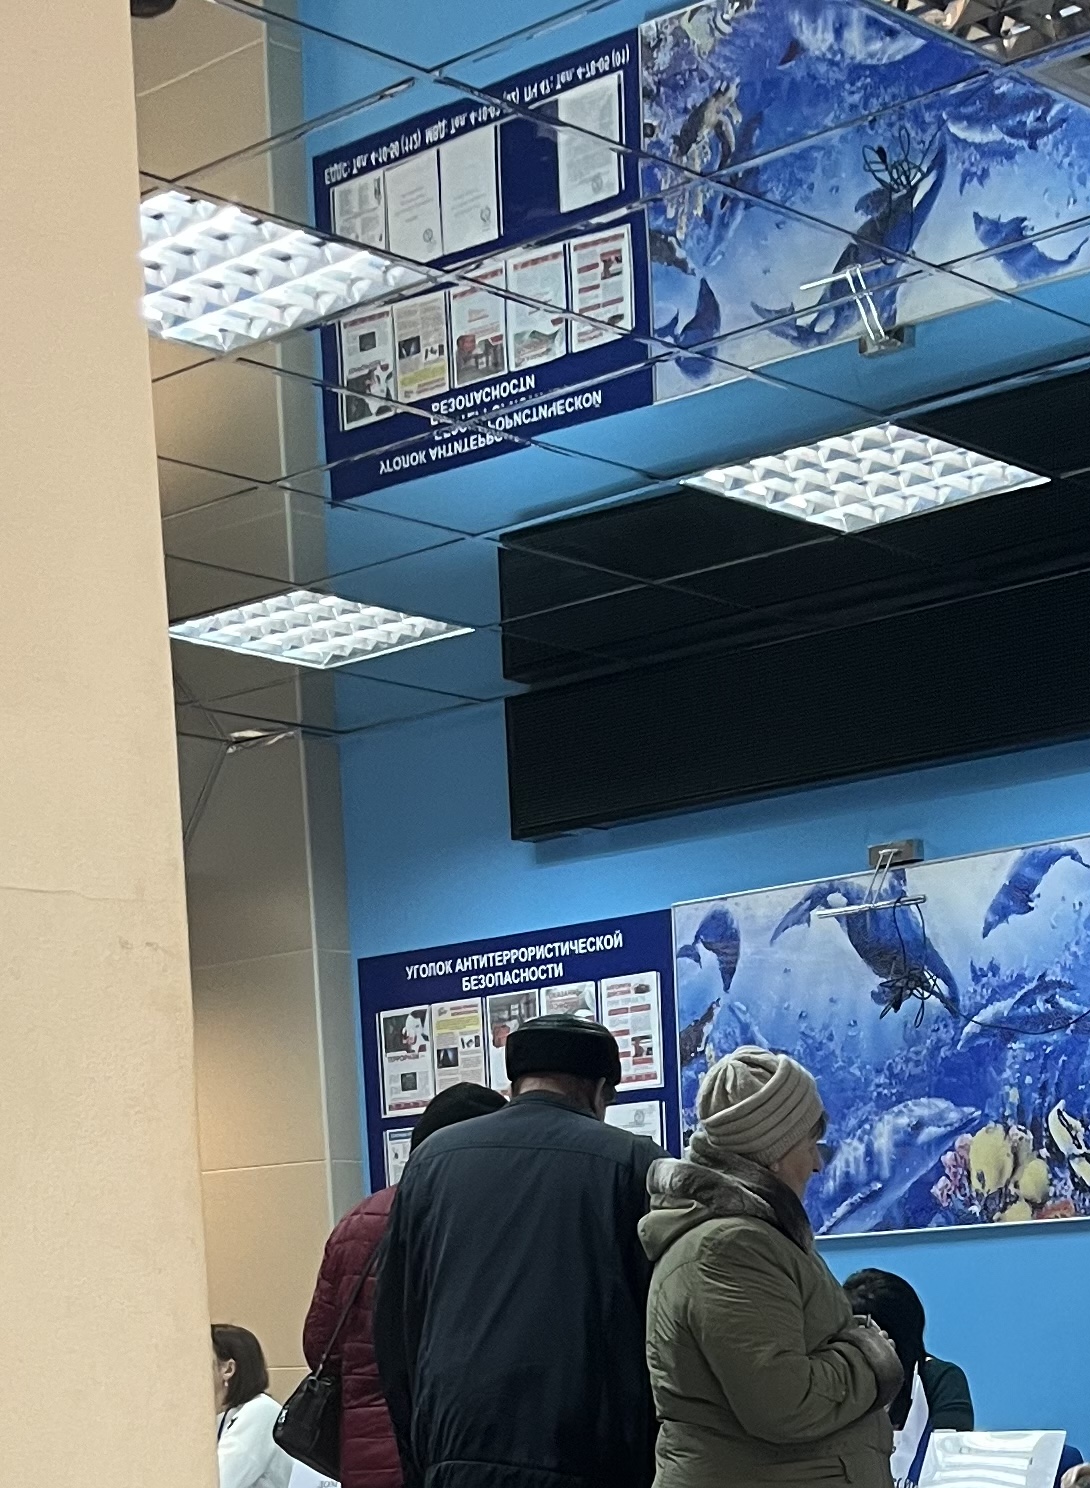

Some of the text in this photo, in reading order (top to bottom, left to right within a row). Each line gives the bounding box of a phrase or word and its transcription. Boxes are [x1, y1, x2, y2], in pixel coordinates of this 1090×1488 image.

[405, 929, 623, 981] УГОЛОК АНТИТЕРРОРИСТИЧЕСКОЙ
[462, 962, 564, 992] БЕЗОПАСНОСТИ
